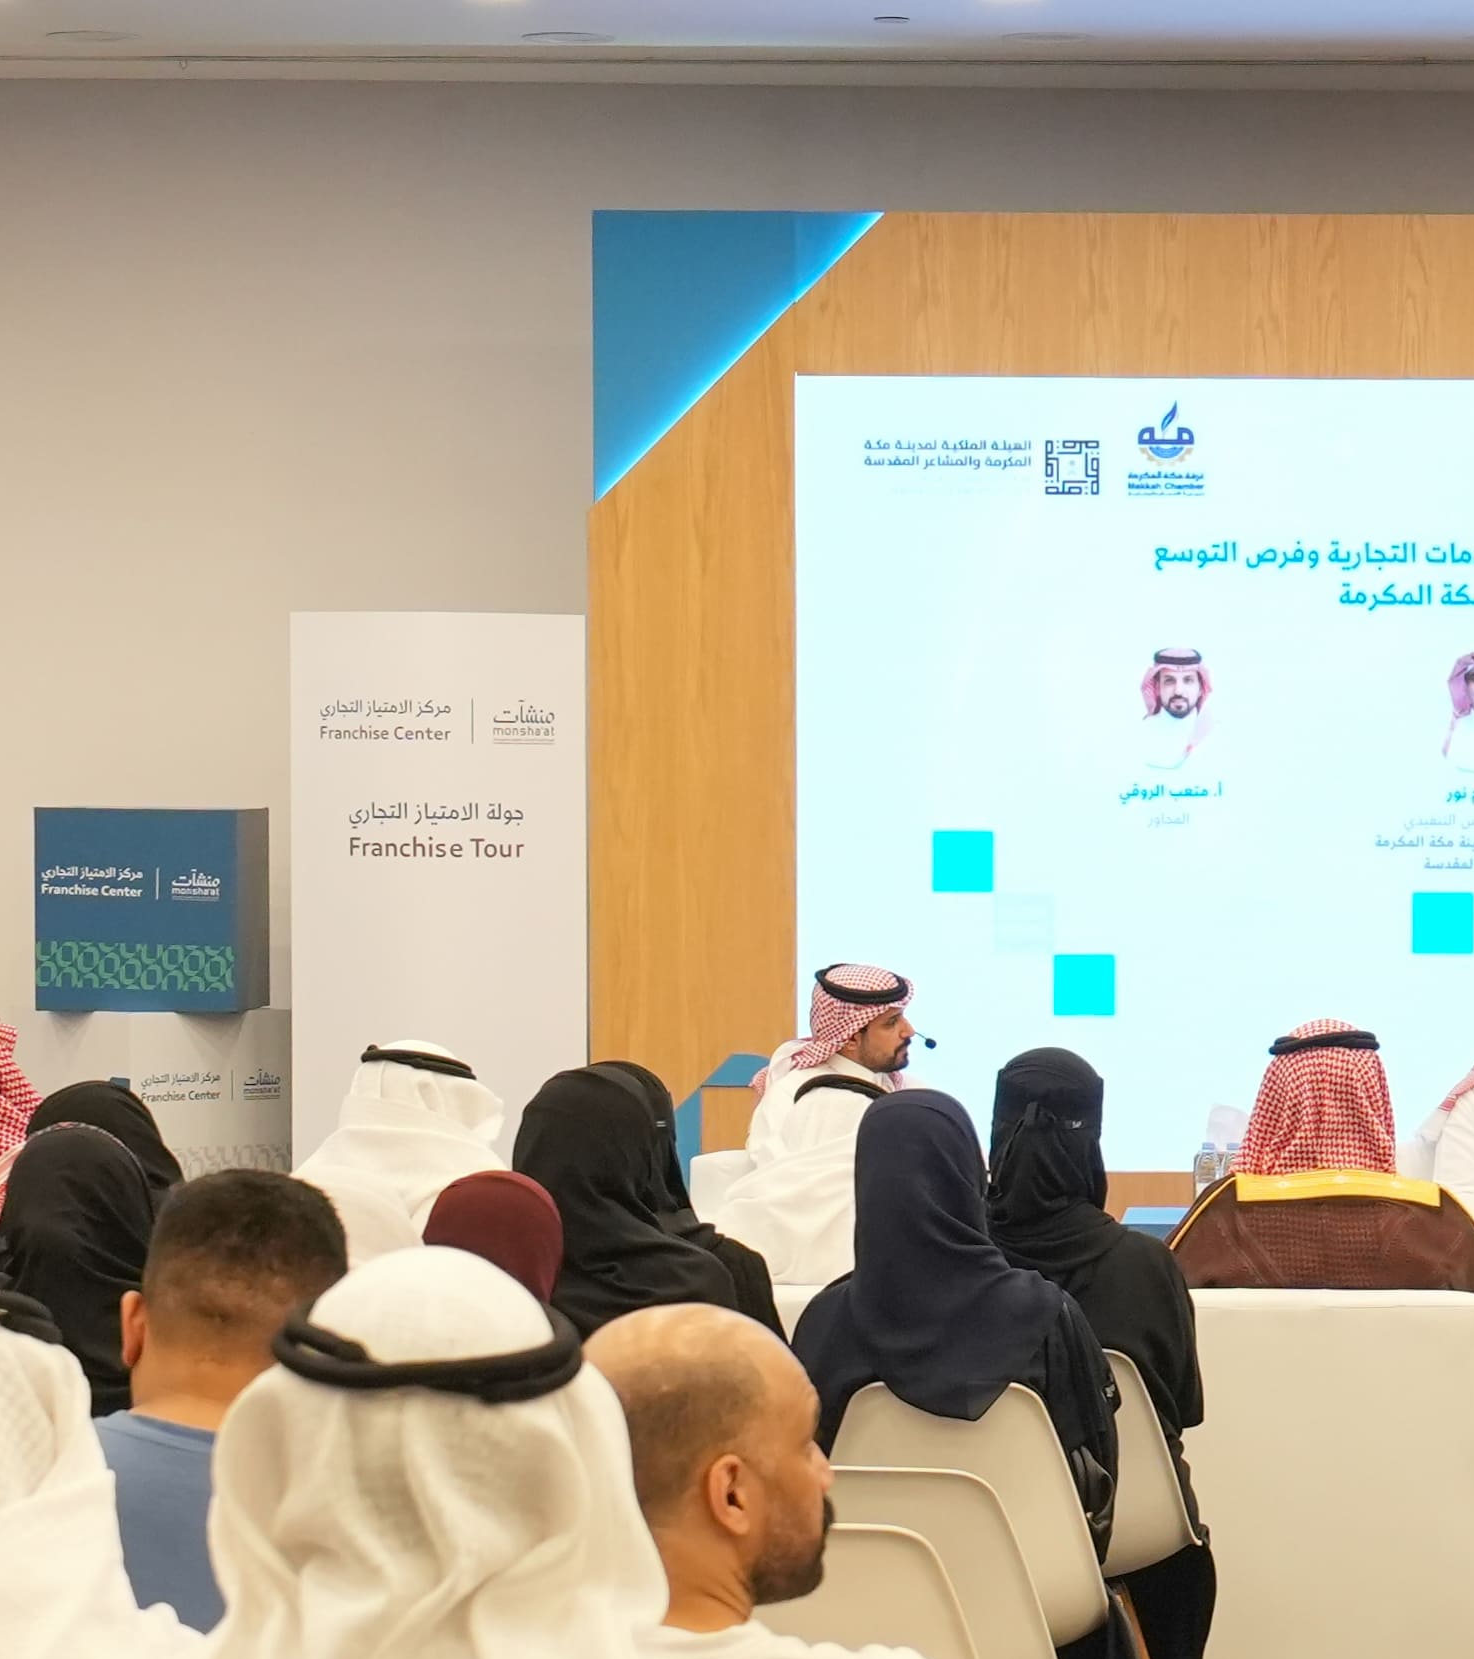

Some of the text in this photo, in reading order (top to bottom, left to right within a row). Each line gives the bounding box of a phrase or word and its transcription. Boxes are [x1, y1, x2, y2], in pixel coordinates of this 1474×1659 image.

[864, 439, 890, 450] مكة
[895, 440, 937, 452] لمدينة
[942, 440, 986, 452] الملكية
[864, 455, 1031, 470] المكرمة والمشاعر المقدسة
[1155, 541, 1237, 570] التوسع
[1246, 541, 1319, 568] وفرص
[1328, 541, 1416, 571] التجارية
[1339, 583, 1432, 611] المكرمة
[320, 700, 452, 721] مركز الامتياز التجاري
[493, 699, 555, 724] منشآت
[320, 725, 451, 741] Franchise Center
[1169, 785, 1209, 801] متعب
[1446, 787, 1467, 802] نور
[349, 802, 524, 829] جولة الامتياز التجاري
[349, 836, 524, 858] Franchise Tour
[1375, 835, 1424, 850] المكرمة
[1429, 835, 1454, 848] مكة
[41, 866, 143, 881] مركز الامتياز التجاري
[41, 883, 143, 897] Franchise Center
[188, 1090, 221, 1101] Center
